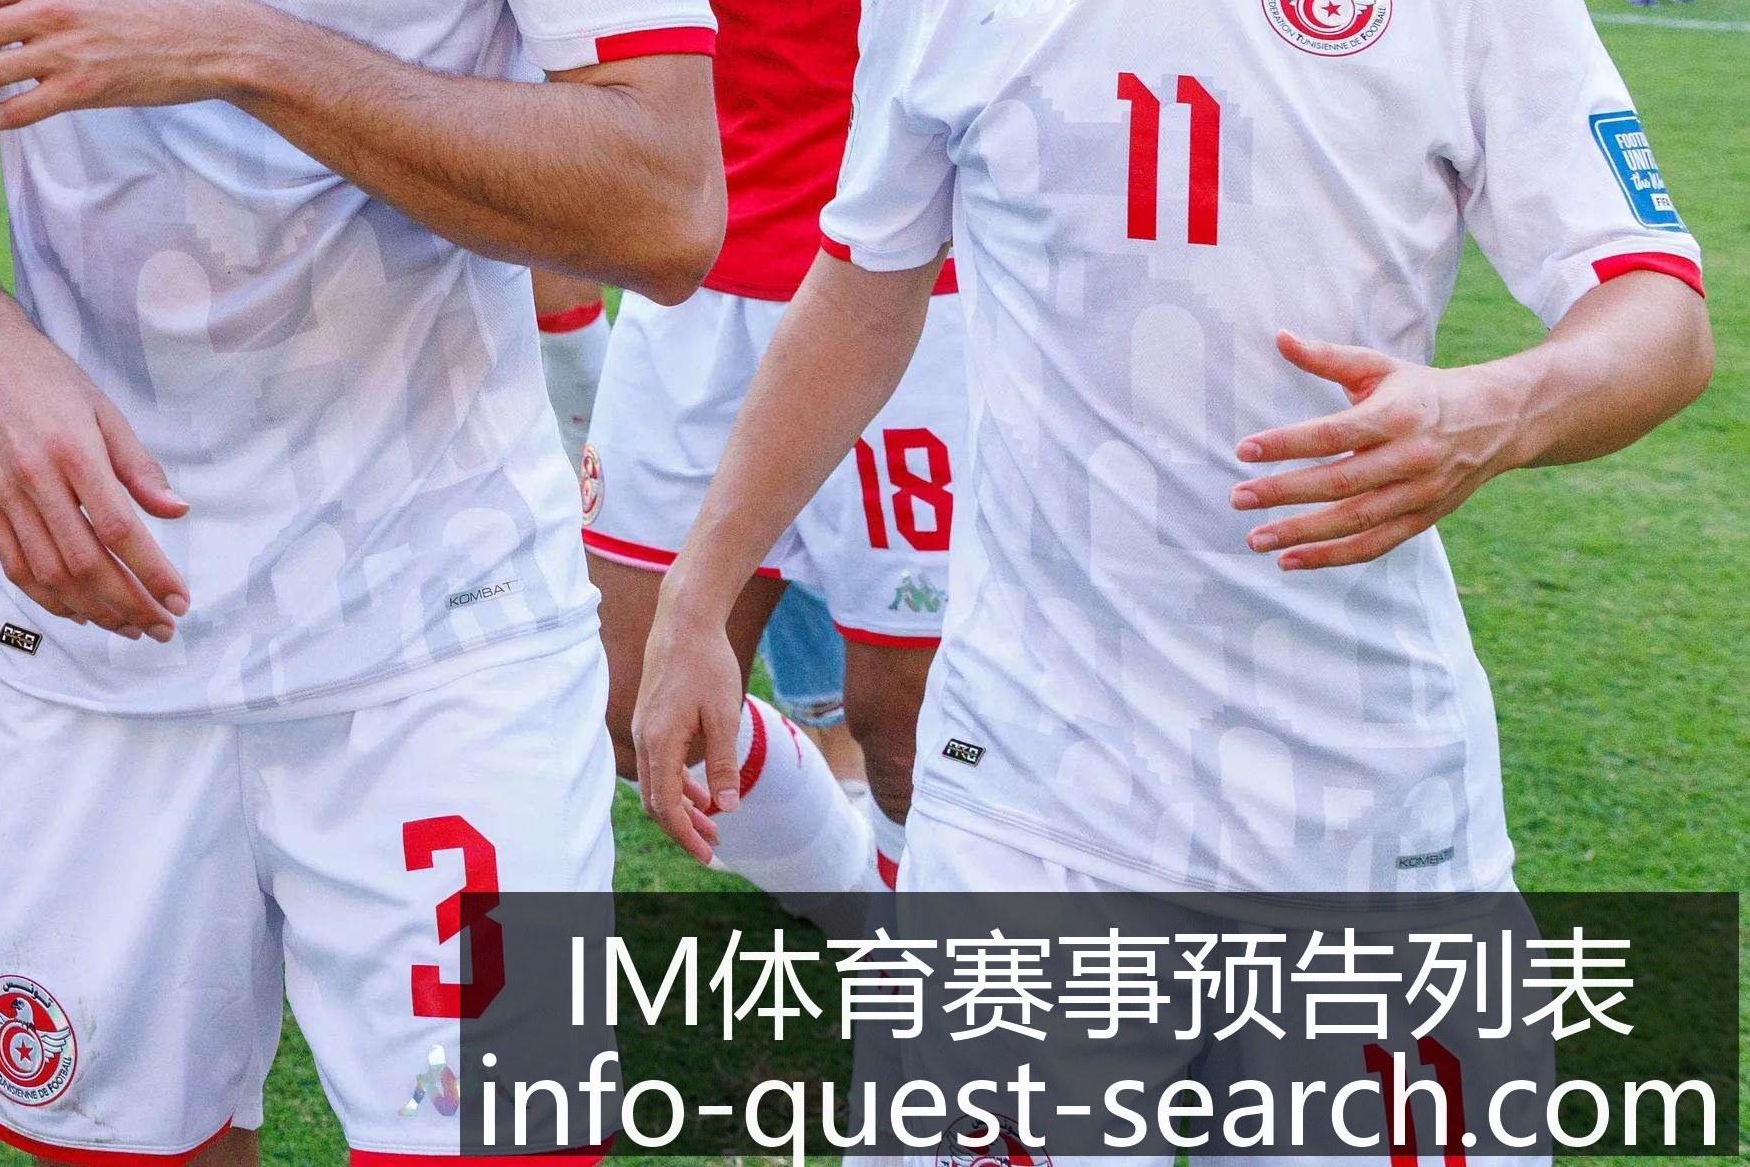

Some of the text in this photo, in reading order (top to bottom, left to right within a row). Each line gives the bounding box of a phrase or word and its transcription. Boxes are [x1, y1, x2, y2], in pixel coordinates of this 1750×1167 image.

[1295, 34, 1349, 51] TUNISIENNE
[1350, 37, 1362, 48] DE
[1361, 7, 1387, 41] FOOTBALL
[1117, 72, 1220, 246] 11
[853, 427, 953, 551] 18
[449, 580, 518, 607] KOMBAT
[402, 815, 506, 1019] 3
[39, 1087, 49, 1098] DE
[49, 1056, 72, 1094] FOOTBALL
